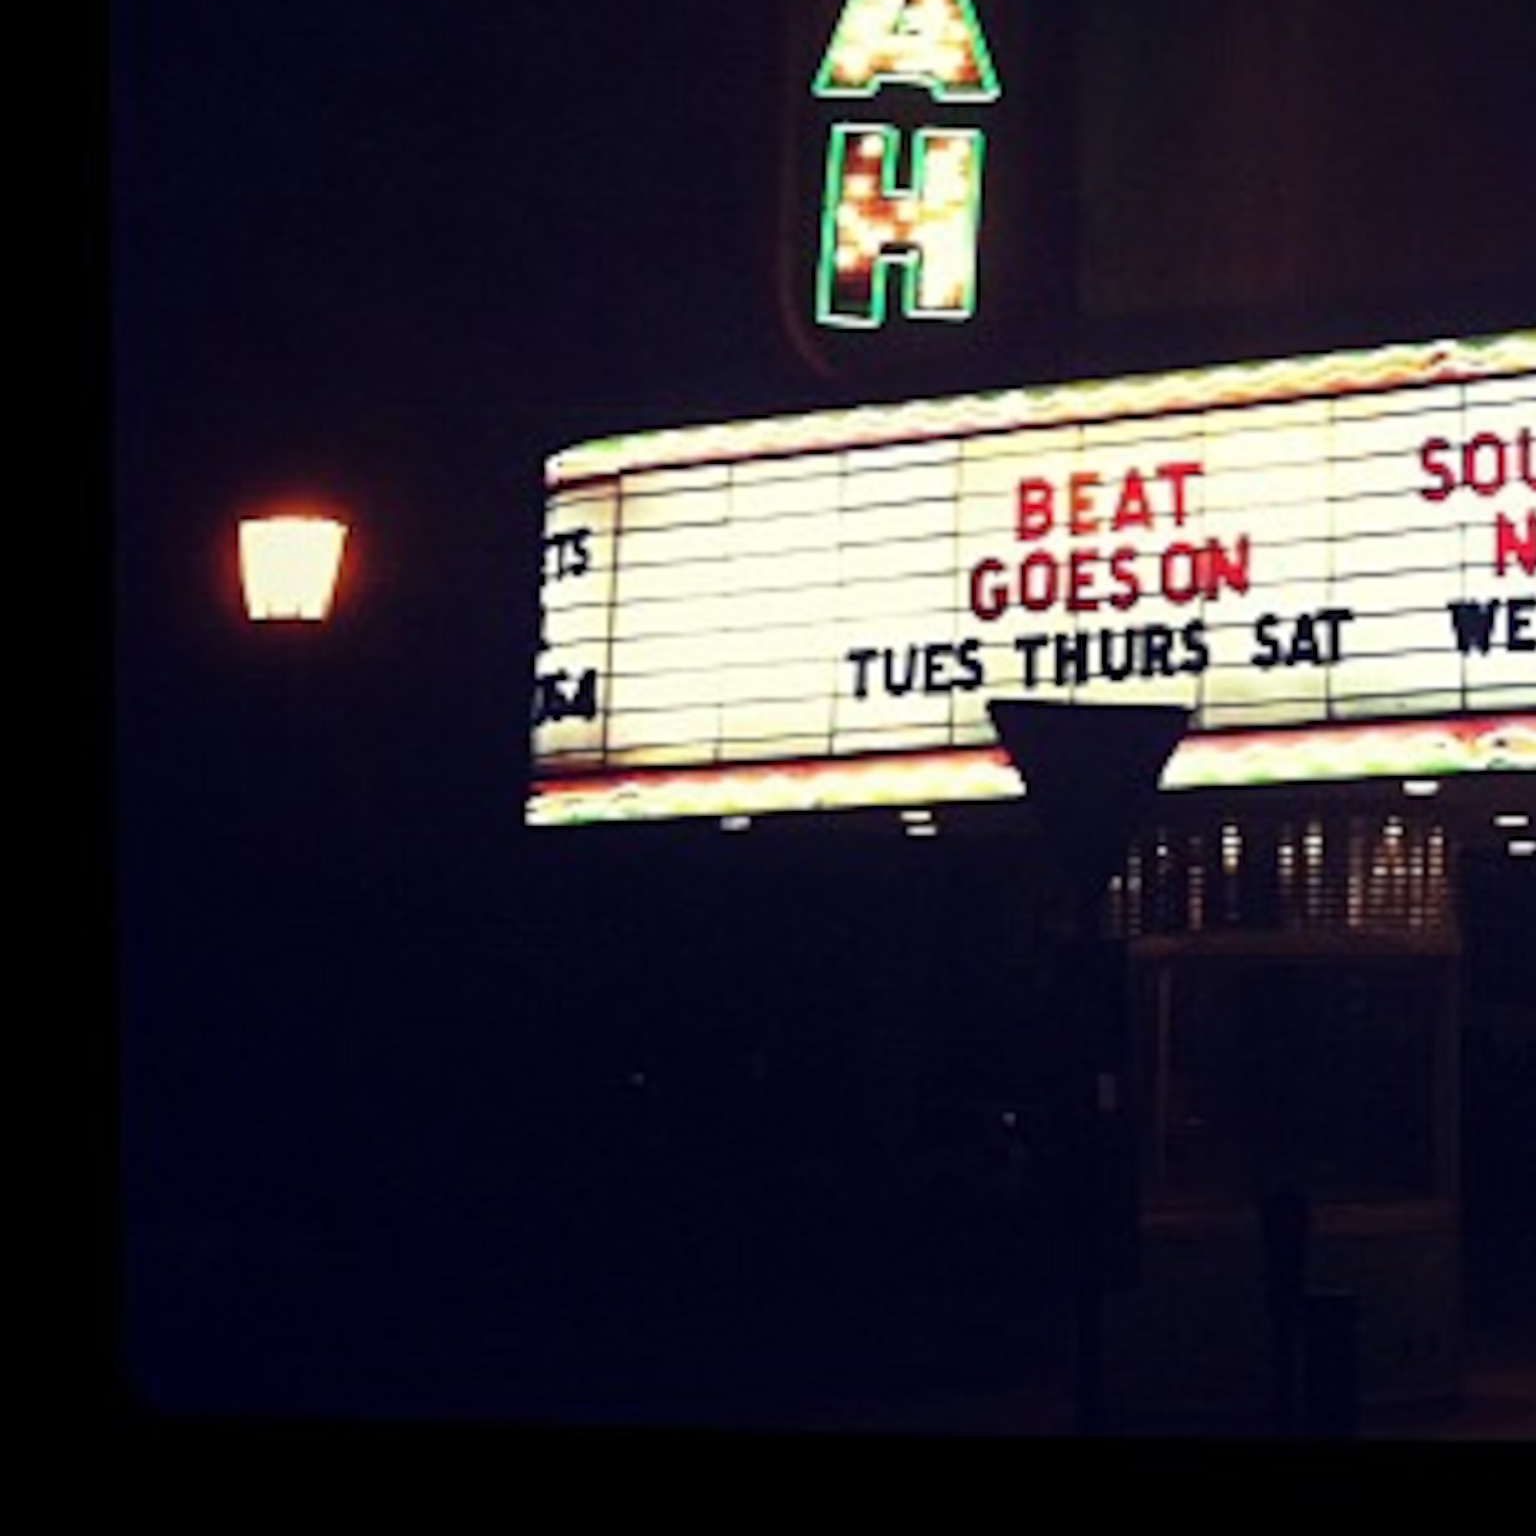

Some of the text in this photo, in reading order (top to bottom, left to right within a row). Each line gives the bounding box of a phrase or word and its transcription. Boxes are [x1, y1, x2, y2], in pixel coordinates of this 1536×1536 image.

[1015, 462, 1204, 542] BEAT
[969, 532, 1251, 622] GOES ON
[846, 608, 1353, 701] TUES THURS SAT
